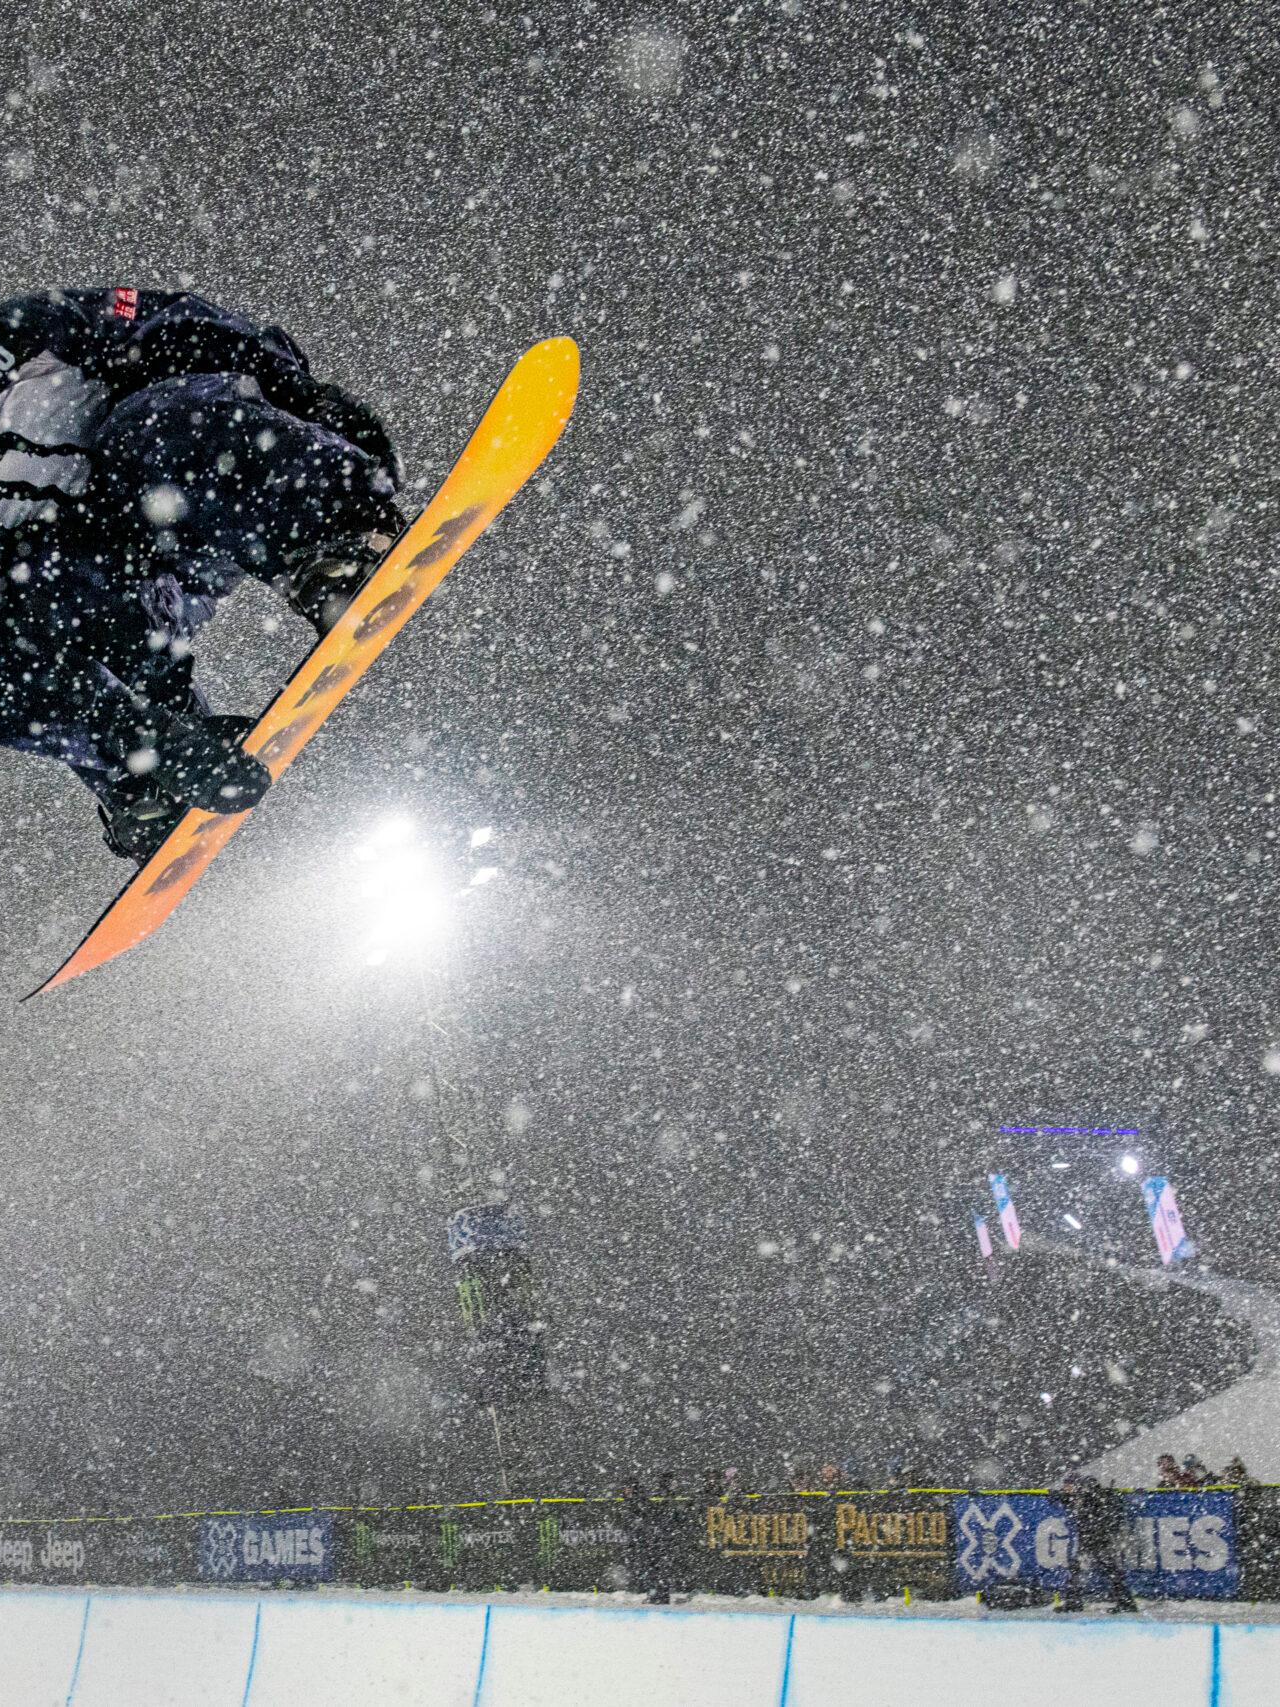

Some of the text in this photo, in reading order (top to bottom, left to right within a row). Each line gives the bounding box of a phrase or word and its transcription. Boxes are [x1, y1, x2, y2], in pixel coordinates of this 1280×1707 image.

[41, 1530, 85, 1575] Jeep
[243, 1527, 324, 1566] GAMES
[1035, 1515, 1230, 1572] GMES
